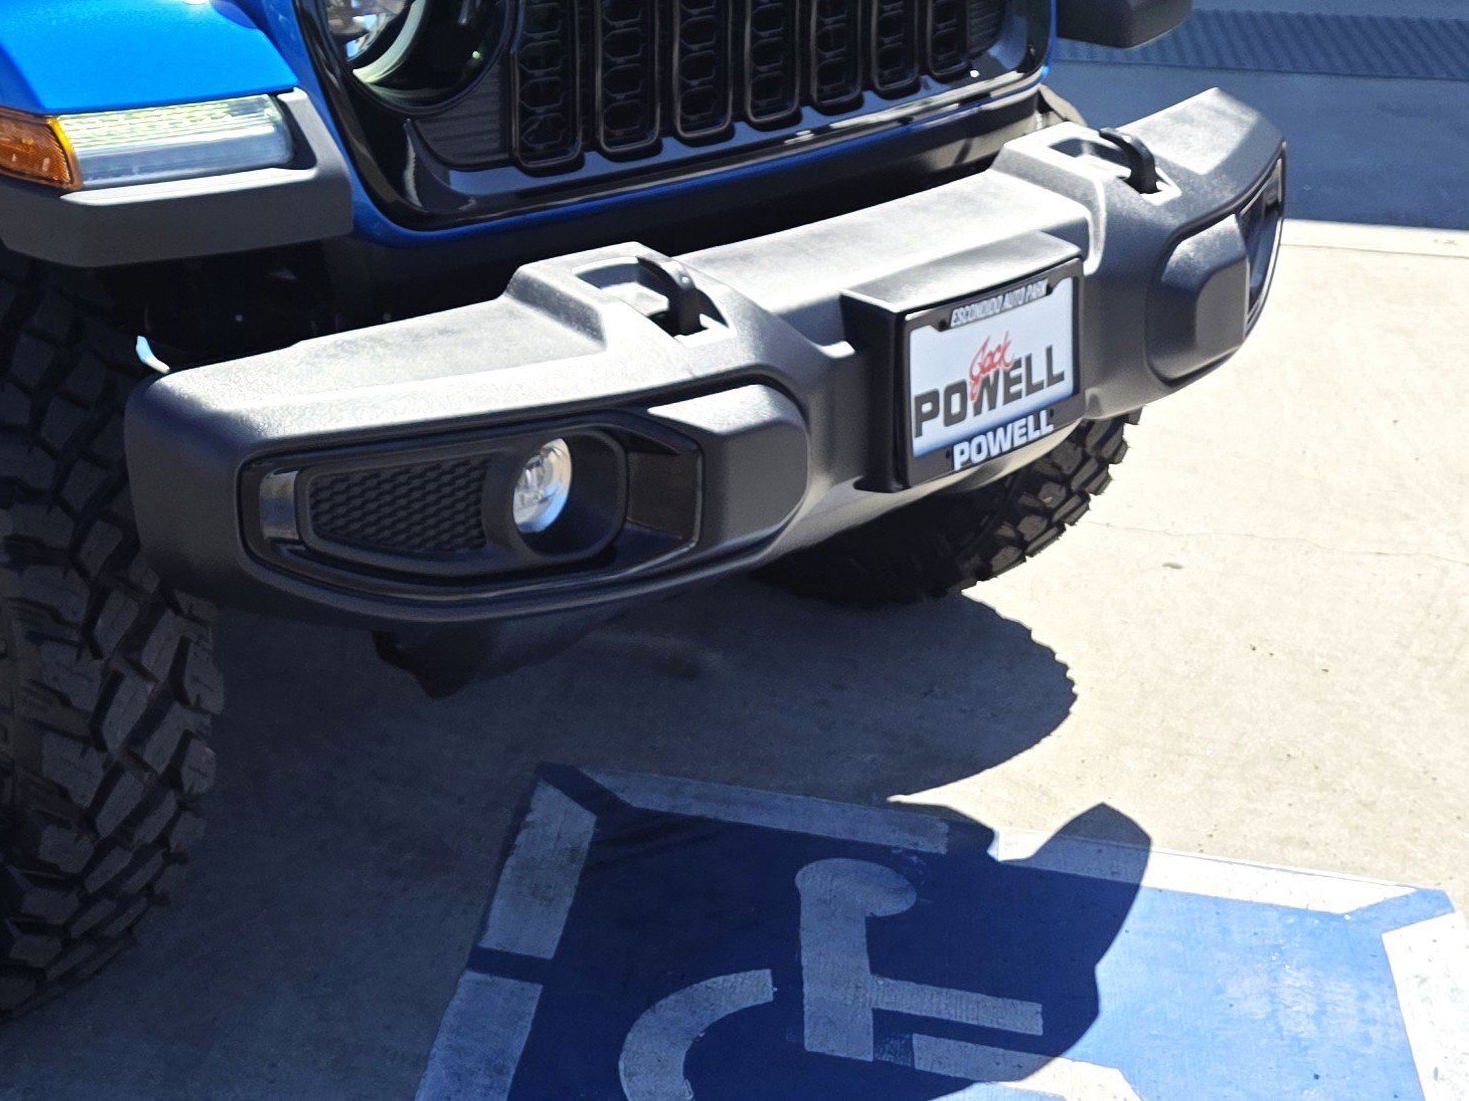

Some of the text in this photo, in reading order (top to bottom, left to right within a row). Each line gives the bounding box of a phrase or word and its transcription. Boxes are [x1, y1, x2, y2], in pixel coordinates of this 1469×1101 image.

[914, 344, 1065, 439] POWELL
[969, 331, 1013, 402] Jack
[953, 409, 1054, 471] POWELL
